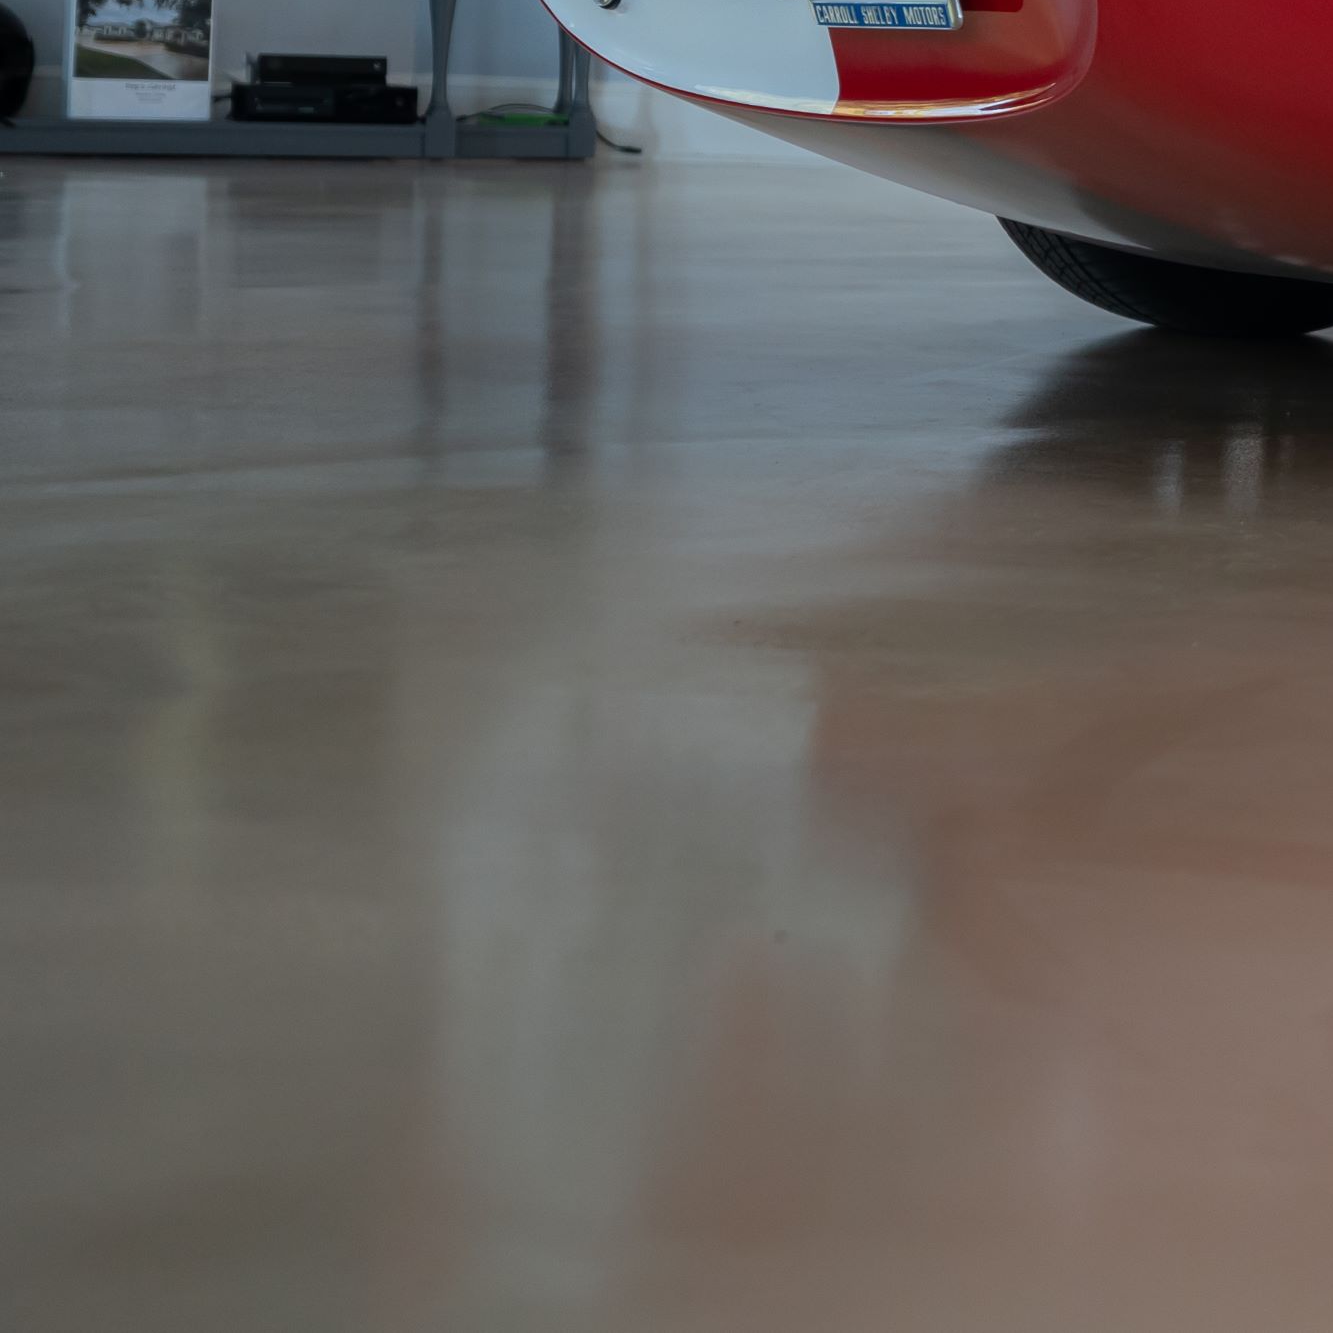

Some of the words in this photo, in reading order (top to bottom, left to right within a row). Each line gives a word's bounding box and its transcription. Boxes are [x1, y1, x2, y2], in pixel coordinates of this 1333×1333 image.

[815, 4, 859, 24] CARROLL
[861, 5, 899, 25] SHELBY
[903, 6, 946, 26] MOTORS
